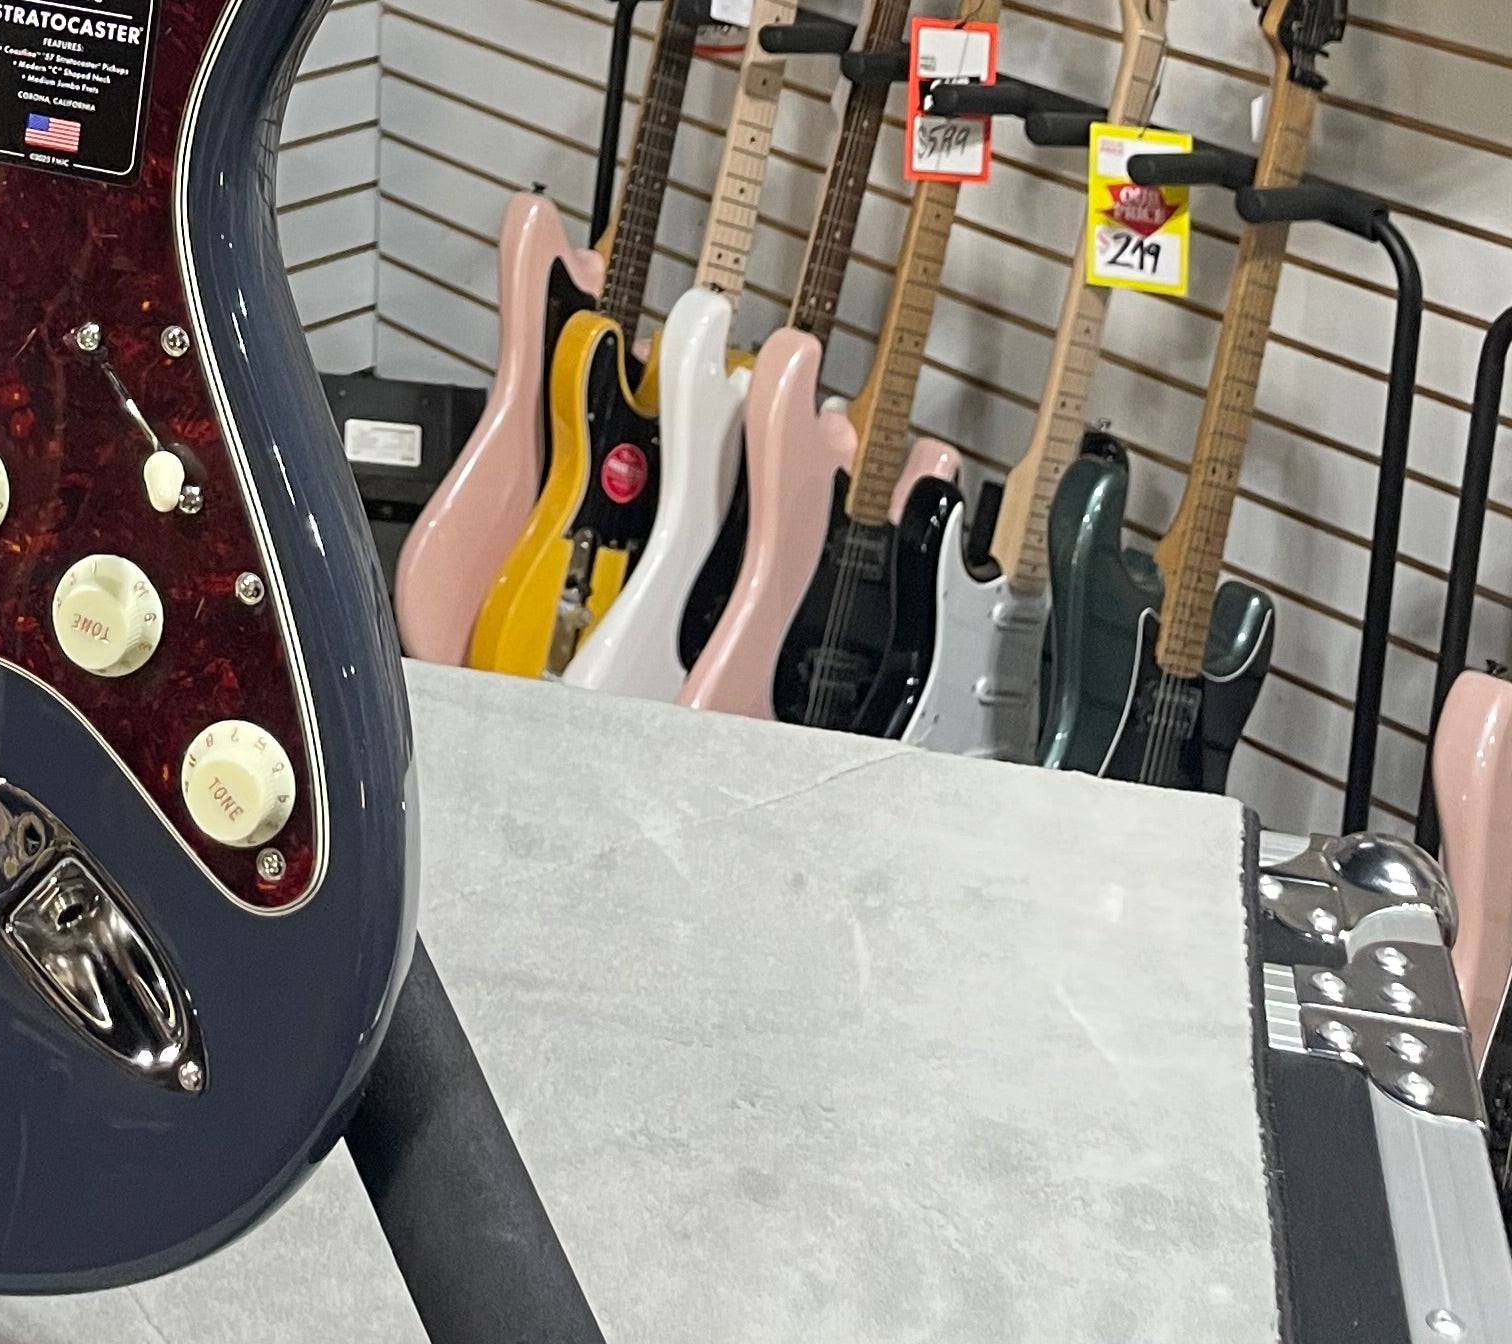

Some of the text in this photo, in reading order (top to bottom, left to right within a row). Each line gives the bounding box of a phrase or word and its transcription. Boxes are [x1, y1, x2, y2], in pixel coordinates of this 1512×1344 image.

[1119, 184, 1162, 204] OUR
[1113, 201, 1168, 226] PRICE
[71, 612, 110, 643] TONE
[208, 776, 245, 822] TONE
